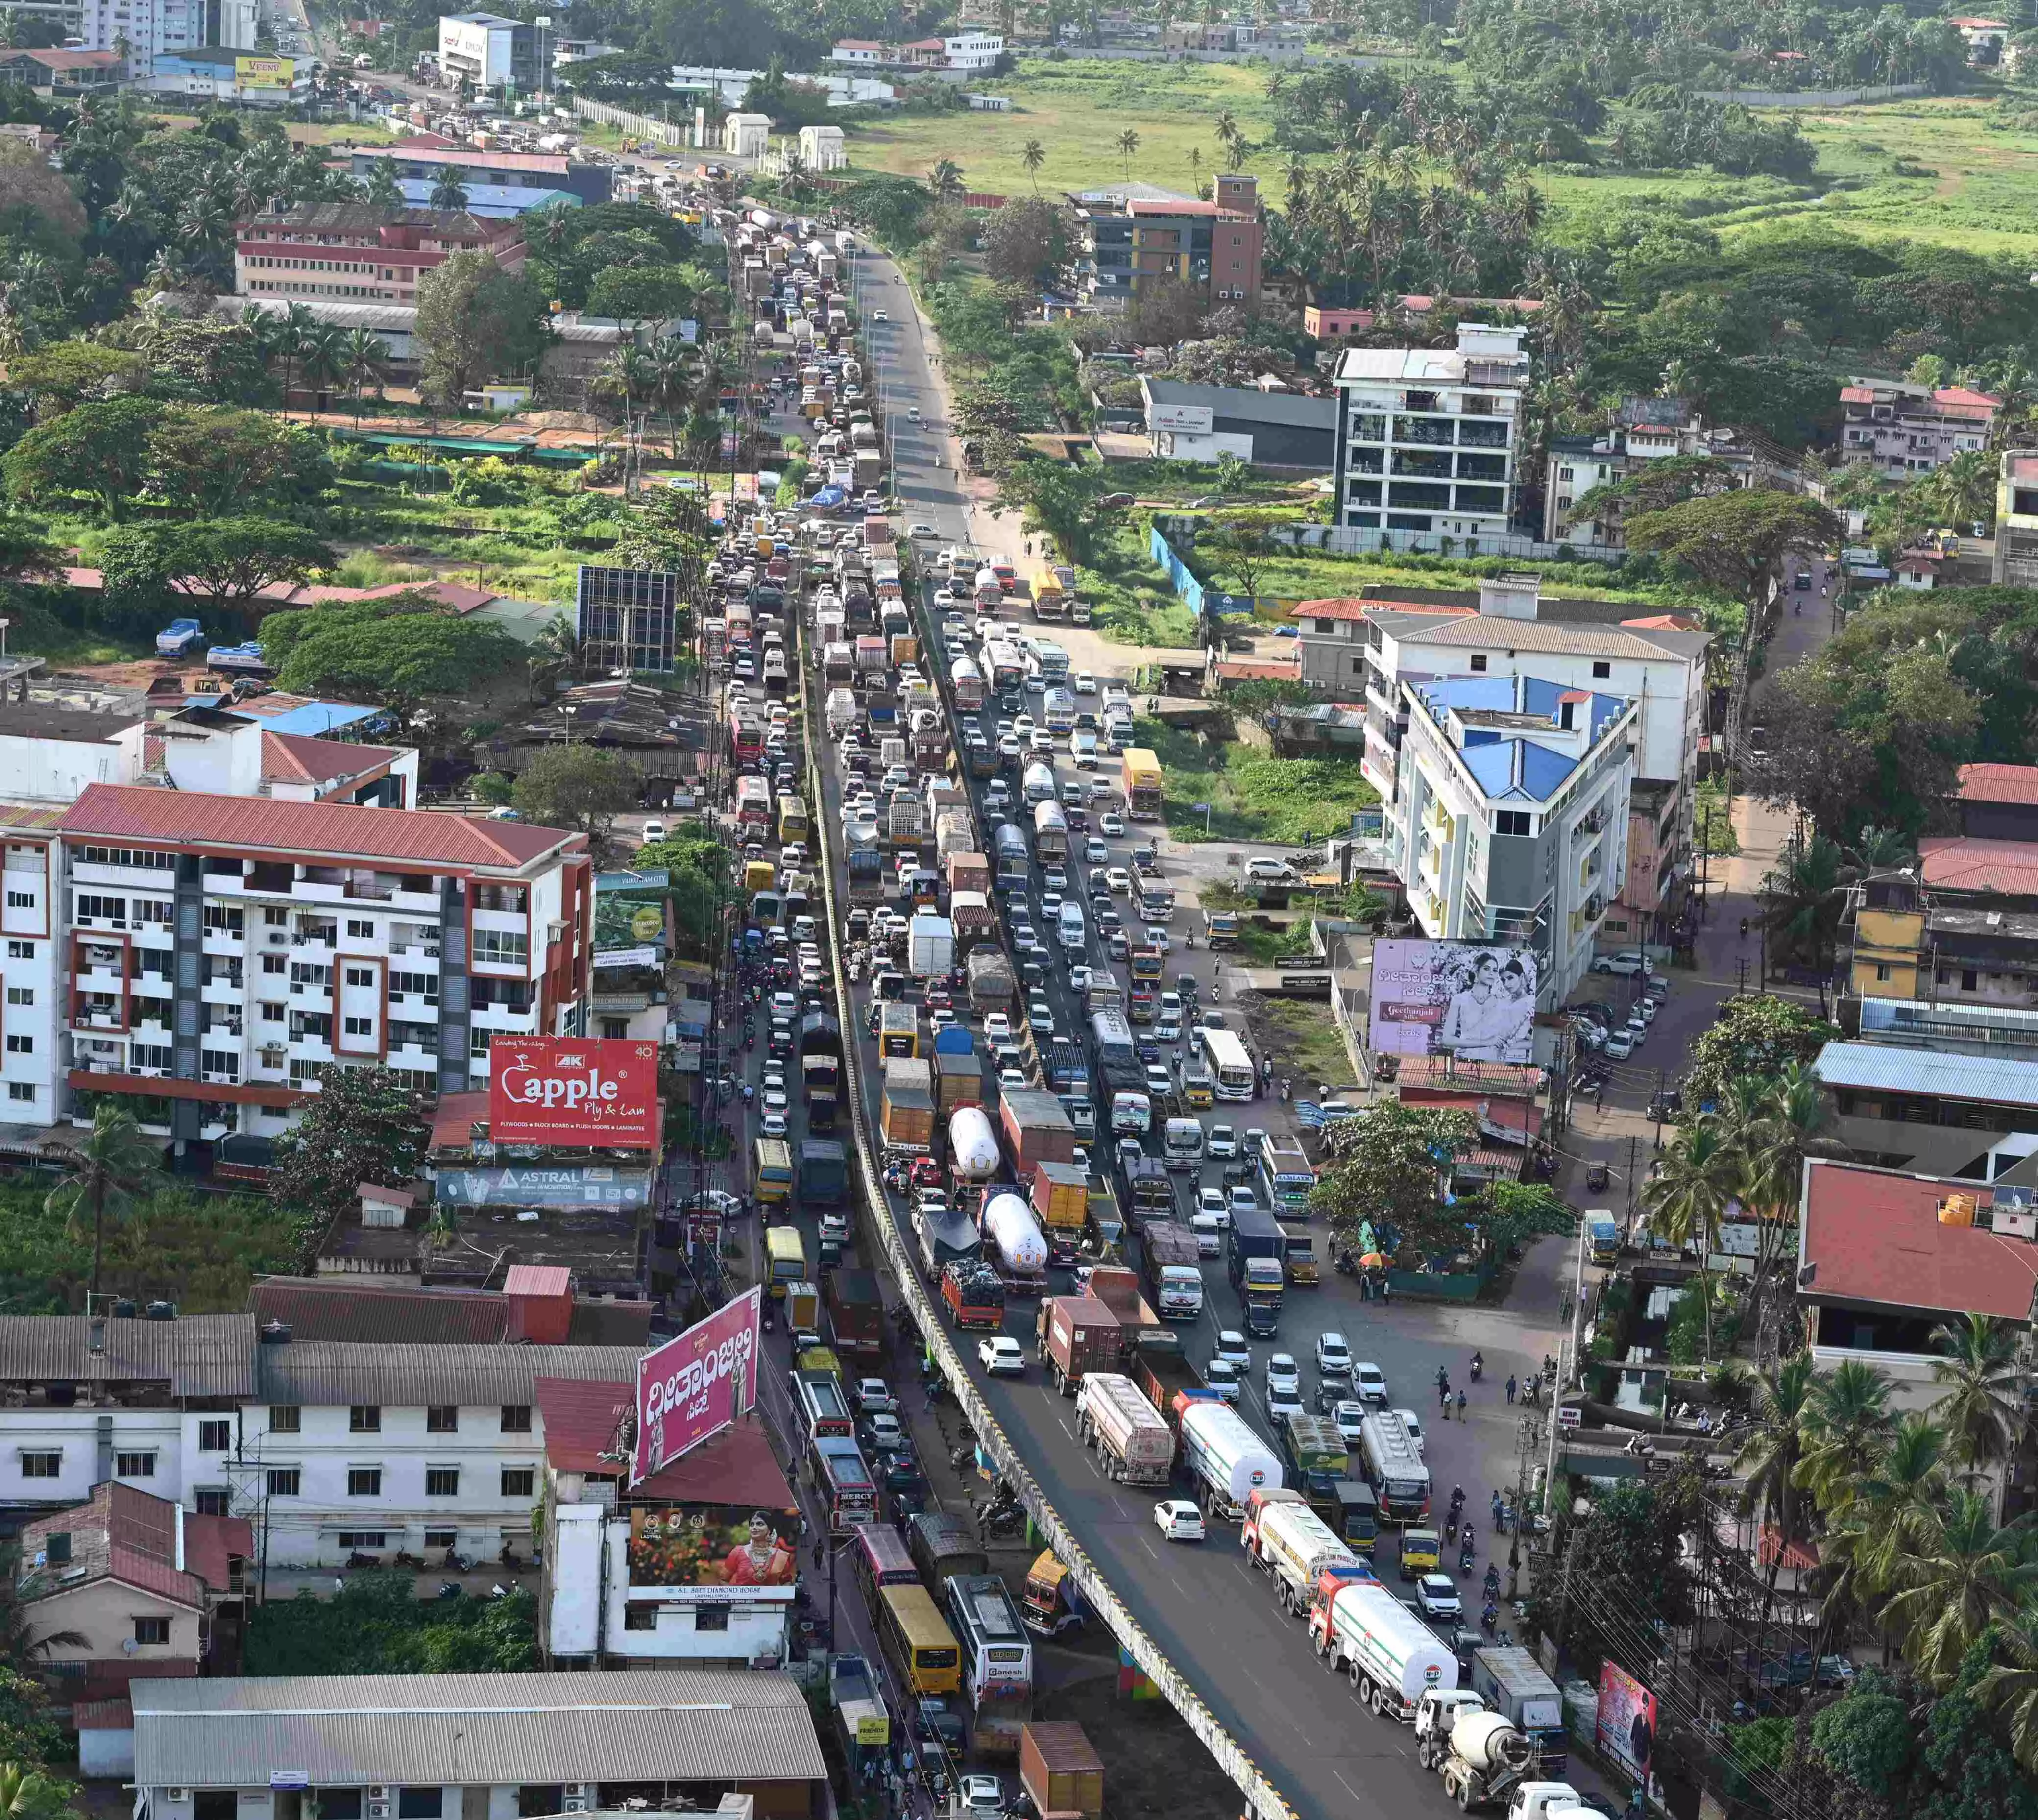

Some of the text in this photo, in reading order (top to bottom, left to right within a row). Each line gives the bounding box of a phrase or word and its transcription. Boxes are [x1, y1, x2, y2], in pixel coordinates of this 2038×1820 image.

[248, 61, 281, 71] VEENU
[1388, 1005, 1433, 1016] Geethanjali
[635, 1047, 652, 1057] 40
[558, 1056, 582, 1066] AK
[524, 1068, 618, 1108] apple
[584, 1102, 645, 1121] Ply & Lam
[520, 1172, 580, 1183] ASTRAL
[1600, 1739, 1620, 1763] ARJUN
[1621, 1755, 1645, 1785] MORAES
